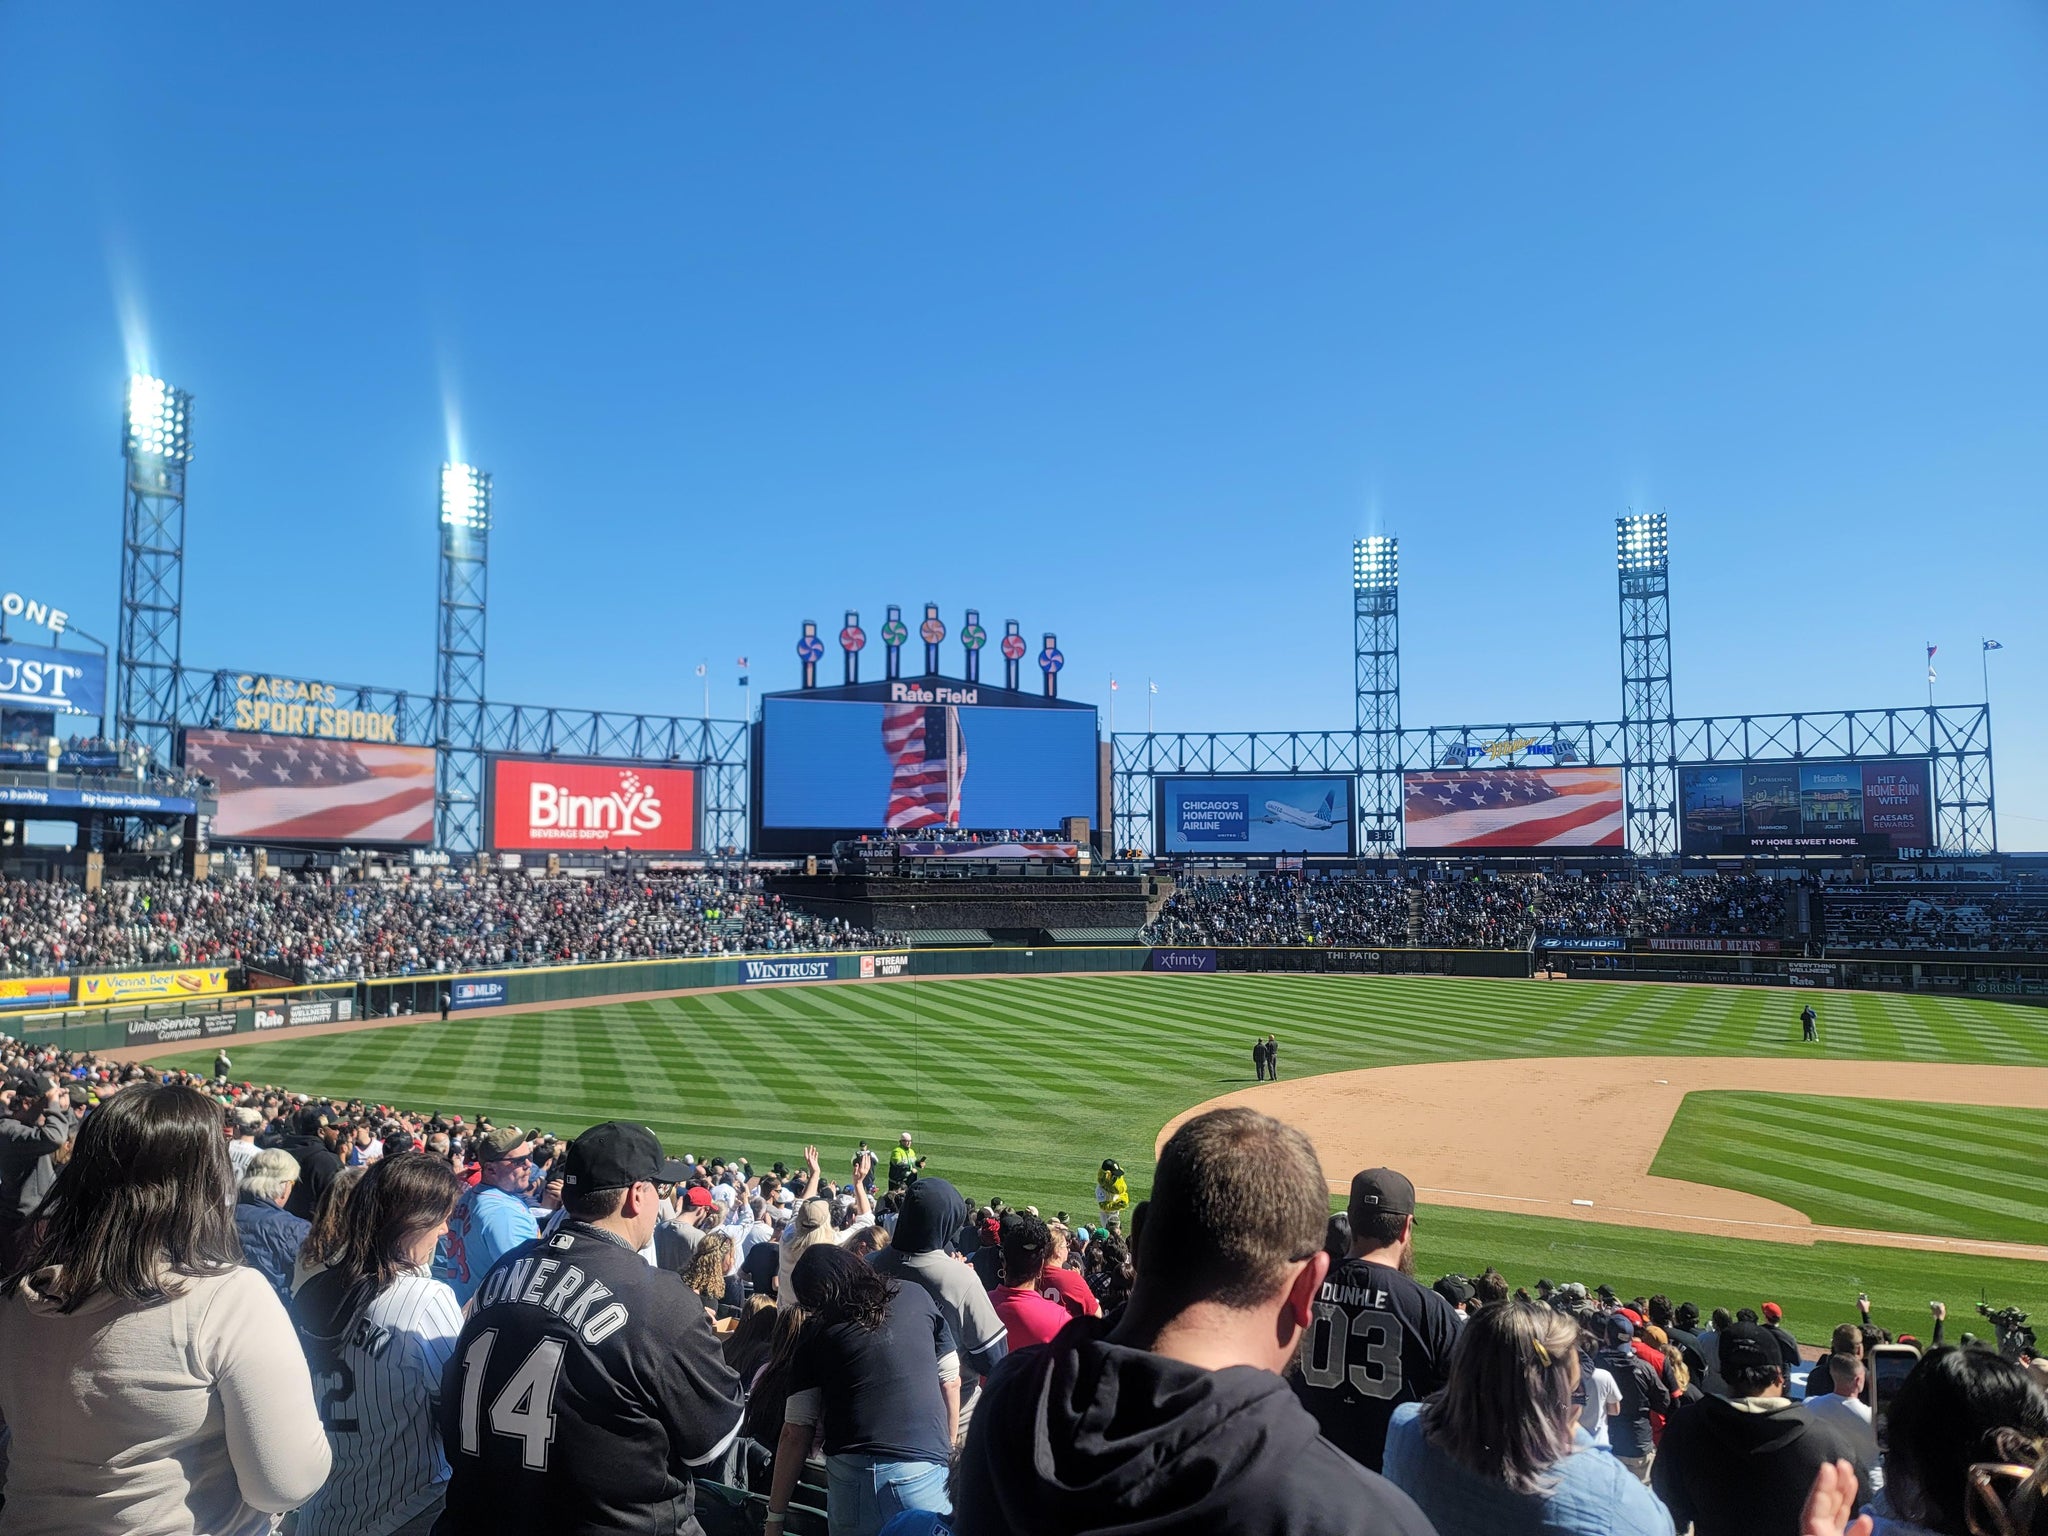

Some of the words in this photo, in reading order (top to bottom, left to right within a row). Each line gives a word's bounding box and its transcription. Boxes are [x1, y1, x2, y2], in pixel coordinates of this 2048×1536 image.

[2, 591, 69, 633] ONE
[236, 675, 336, 703] CAESARS
[891, 683, 934, 703] Rate
[936, 687, 977, 704] Field
[236, 698, 397, 743] SPORTSBOOK
[1527, 744, 1552, 755] TIME
[1877, 776, 1896, 784] HIT
[1866, 785, 1896, 796] HOME
[1898, 784, 1919, 796] RUN
[1182, 801, 1239, 810] CHICAGO'S
[1878, 797, 1908, 805] WITH
[1182, 811, 1243, 820] HOMETOWN
[1182, 821, 1220, 830] AIRLINE
[530, 828, 577, 839] BEVERAGE
[578, 829, 610, 839] DEPOT
[413, 849, 451, 865] Modelo
[859, 849, 873, 857] FAN
[1898, 847, 1924, 860] Lite
[1927, 848, 1983, 858] LANDING
[1563, 939, 1620, 948] HYUNDAI
[1650, 938, 1721, 951] WHITTINGHAM
[1727, 940, 1761, 952] MEATS
[875, 955, 909, 967] STREAM
[1161, 952, 1206, 969] xfinity
[1349, 951, 1380, 960] PATIO
[746, 961, 829, 978] WINTRUST
[882, 964, 901, 975] NOW
[106, 976, 147, 988] Vienna
[150, 974, 175, 985] Beef
[1789, 975, 1815, 987] Rate
[1990, 983, 2022, 994] RUSH
[255, 1010, 284, 1029] Rate
[1300, 1301, 1403, 1400] 03
[460, 1327, 568, 1472] 14
